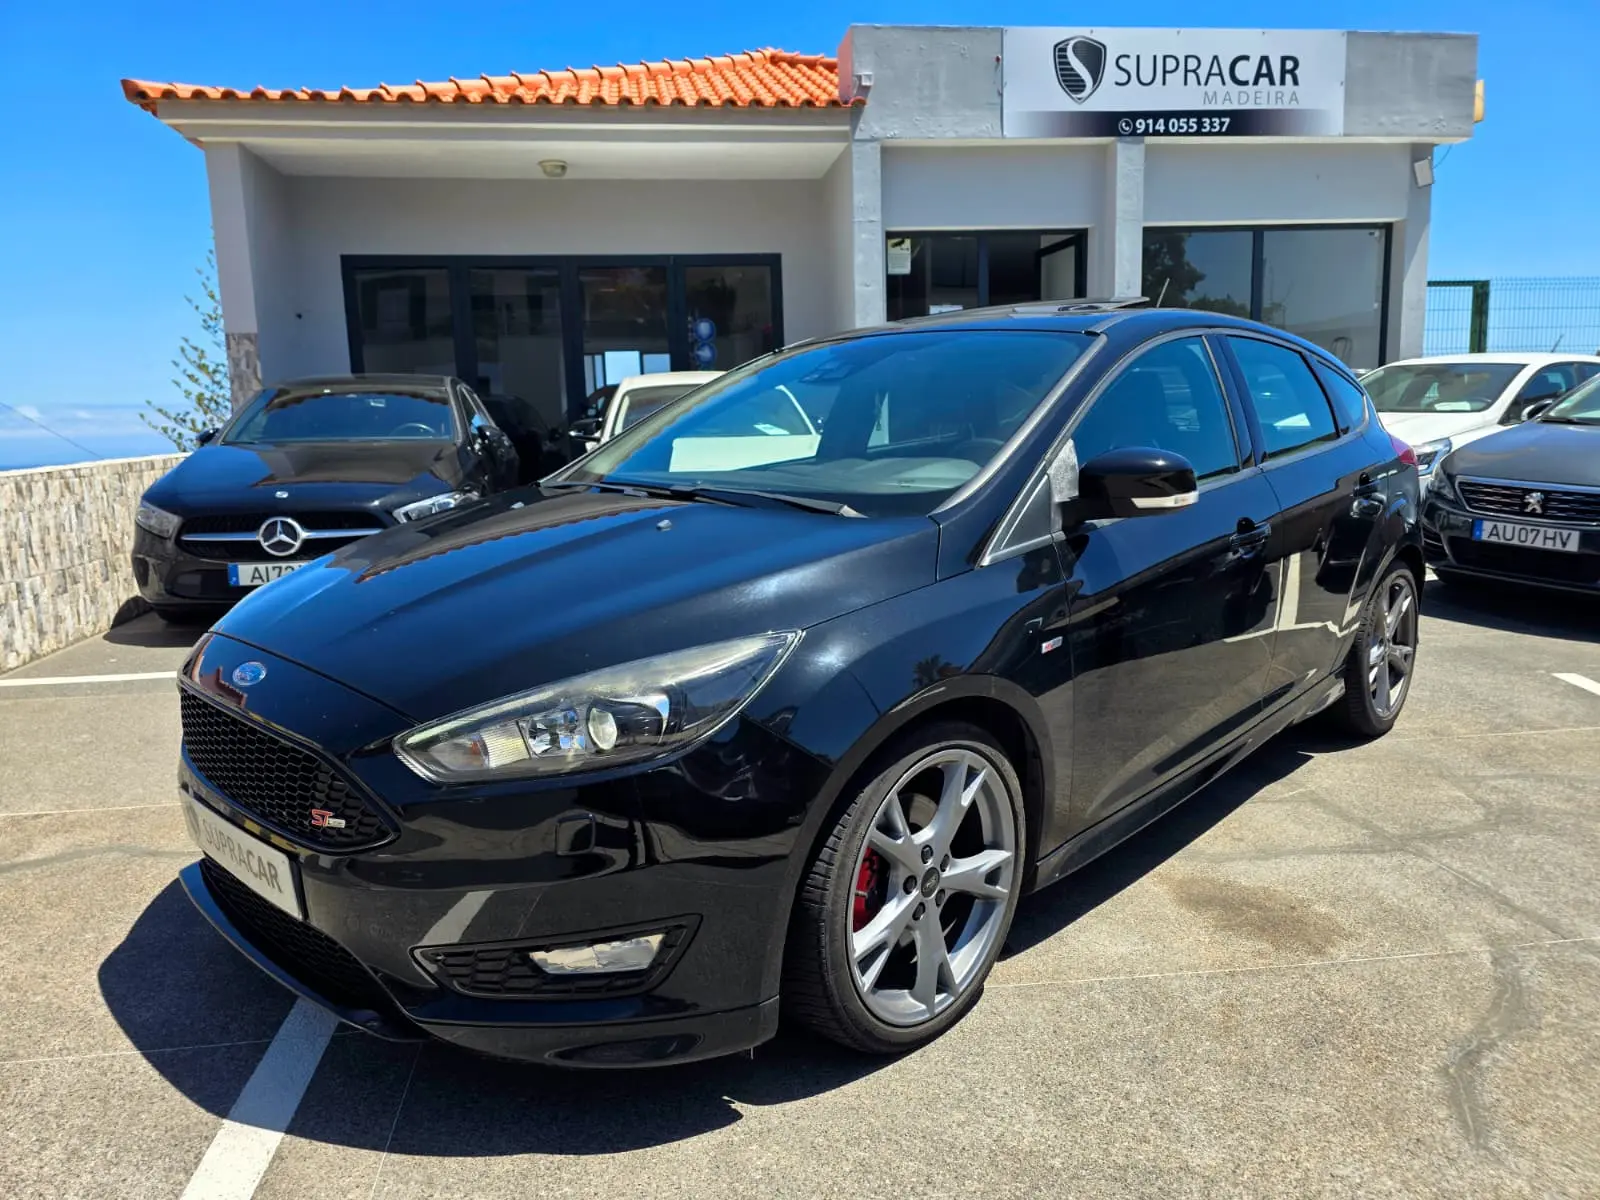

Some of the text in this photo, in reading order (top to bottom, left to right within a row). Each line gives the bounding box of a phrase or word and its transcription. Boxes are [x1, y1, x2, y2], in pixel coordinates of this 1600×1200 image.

[1114, 54, 1300, 87] SUPRACAR
[1203, 90, 1300, 105] MADEIRA
[1135, 117, 1231, 134] 914 055 337
[1487, 523, 1572, 549] AU07HV
[202, 818, 283, 894] SUPRACAR
